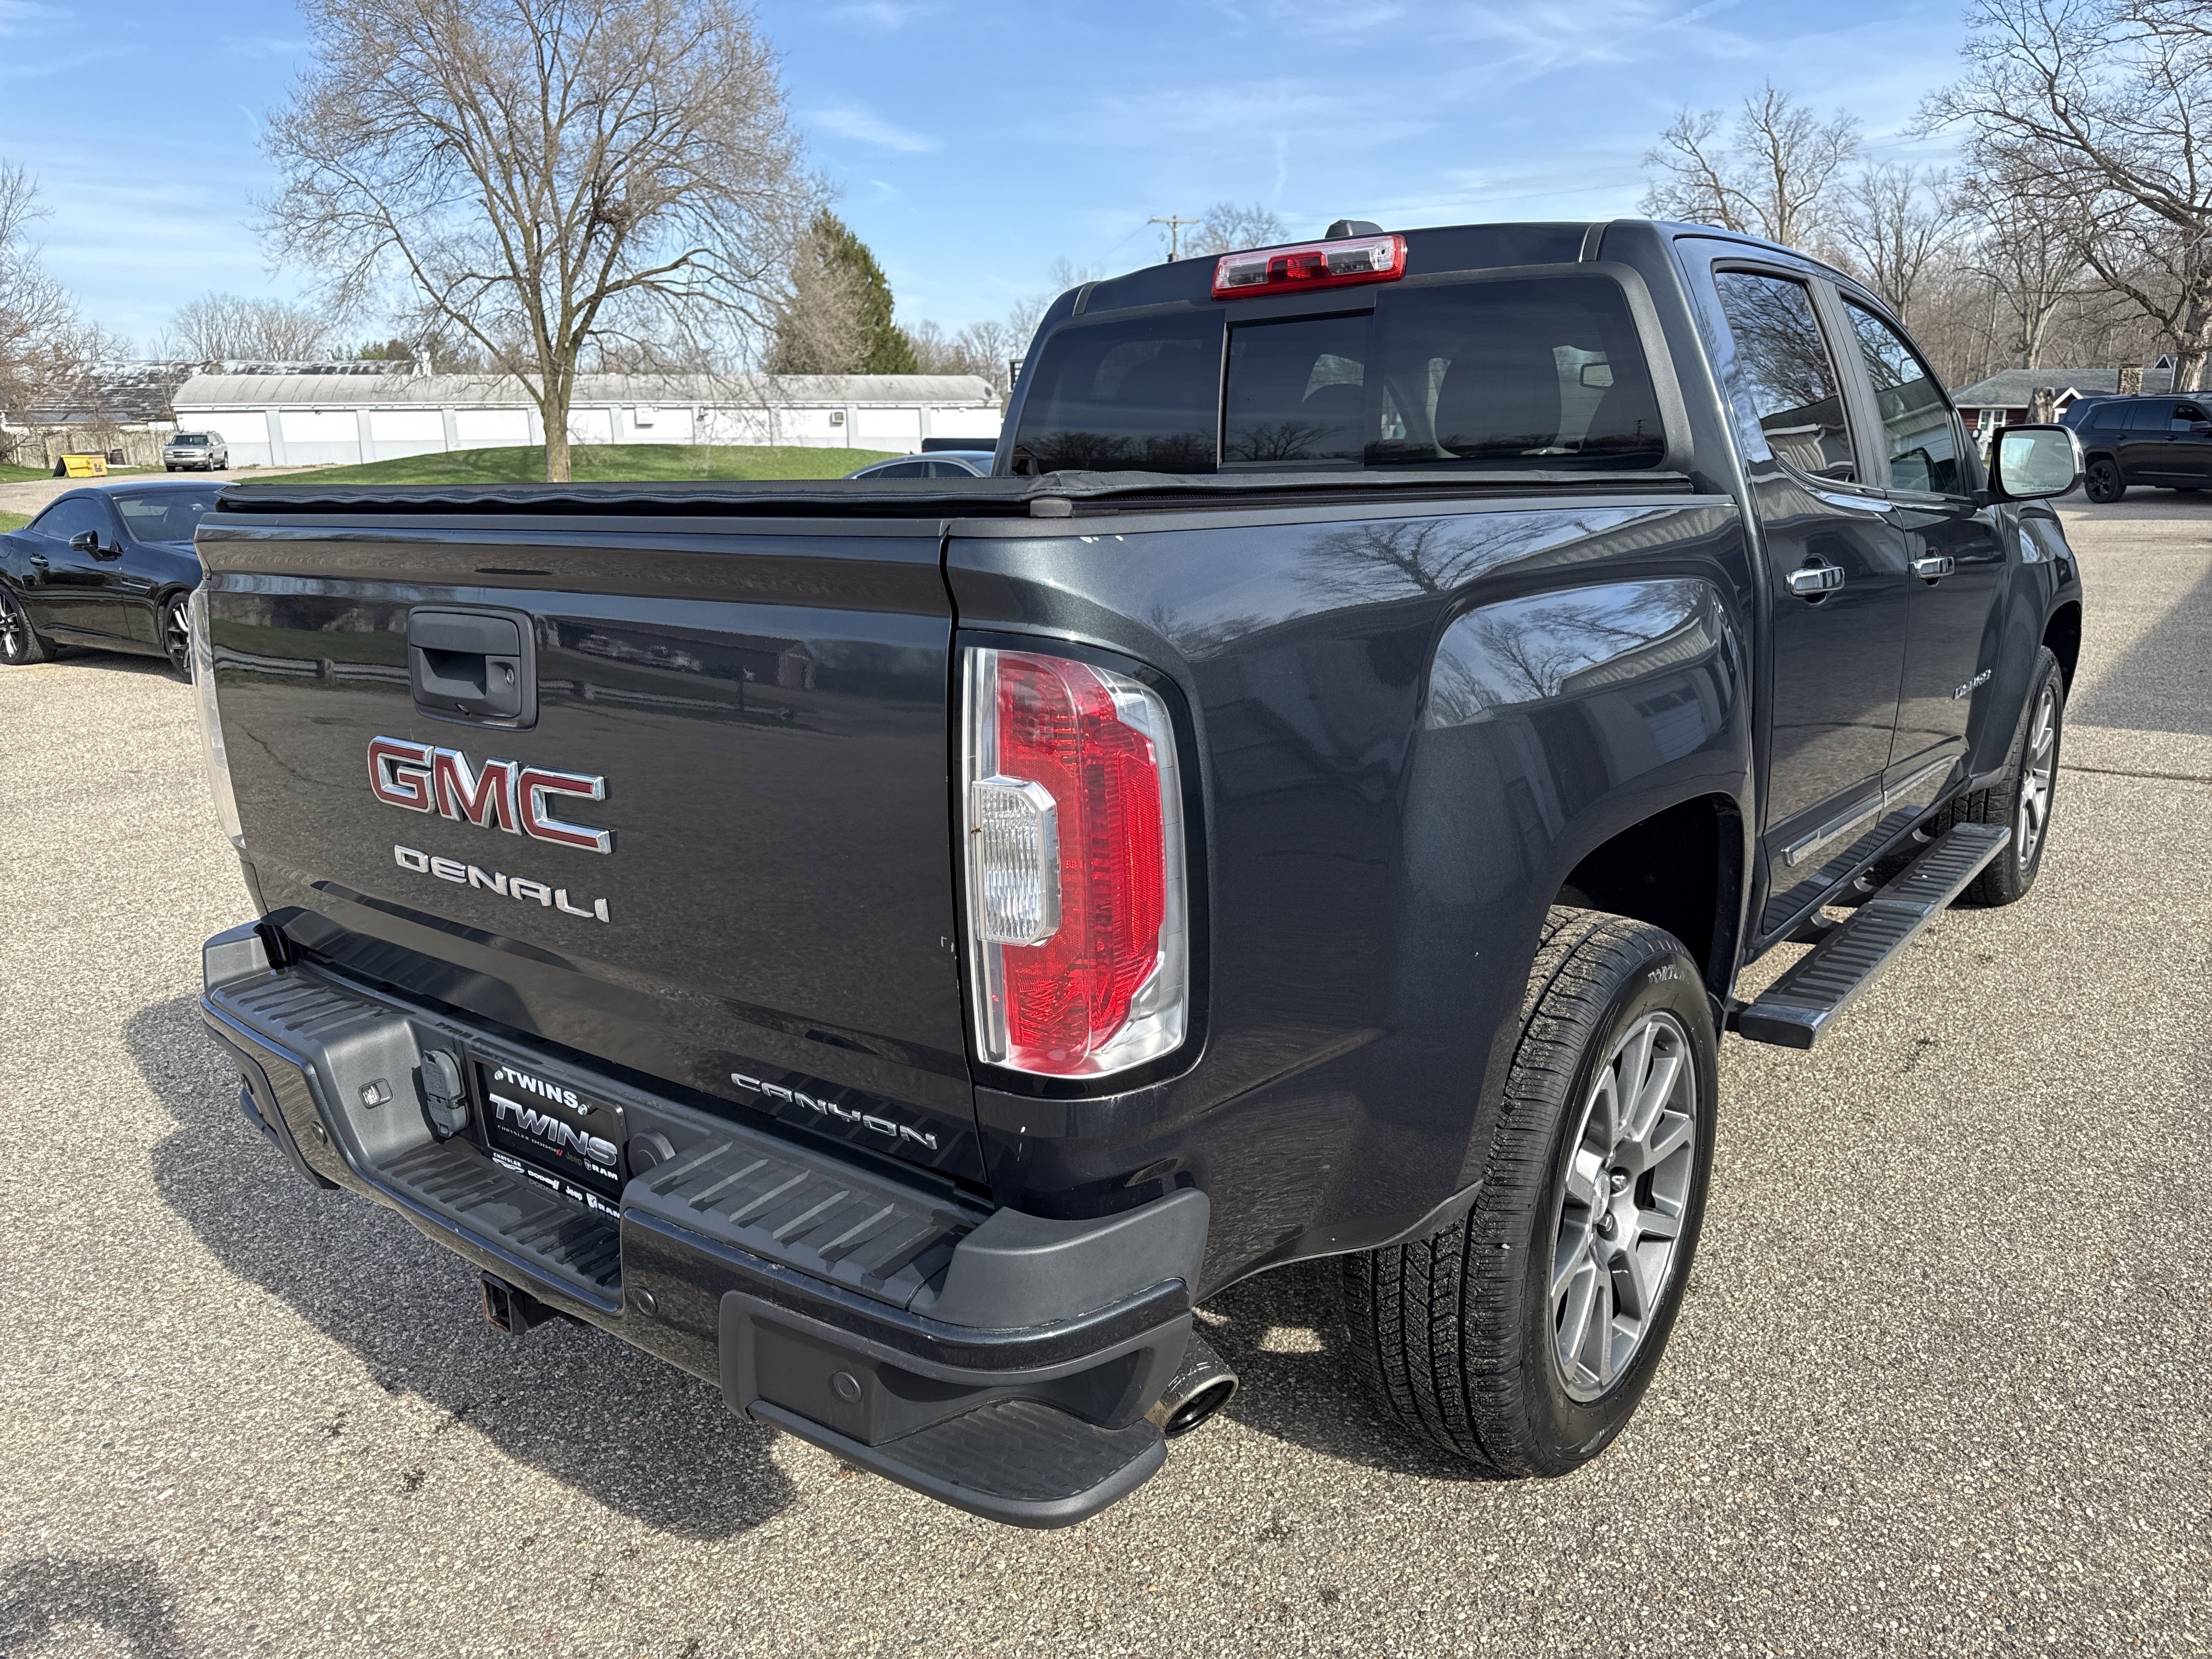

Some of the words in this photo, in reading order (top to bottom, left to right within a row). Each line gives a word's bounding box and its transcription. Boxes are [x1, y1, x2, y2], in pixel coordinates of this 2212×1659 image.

[368, 736, 613, 855] GMC
[394, 844, 610, 923] DENALI
[502, 1066, 578, 1109] TWINS
[731, 1072, 938, 1150] CANYON
[489, 1093, 618, 1166] TWINS
[497, 1125, 529, 1141] CHRYSLER
[565, 1152, 583, 1166] Jeep
[591, 1163, 618, 1181] RAM
[493, 1152, 522, 1167] CHRYSLER
[566, 1185, 583, 1201] Jeep
